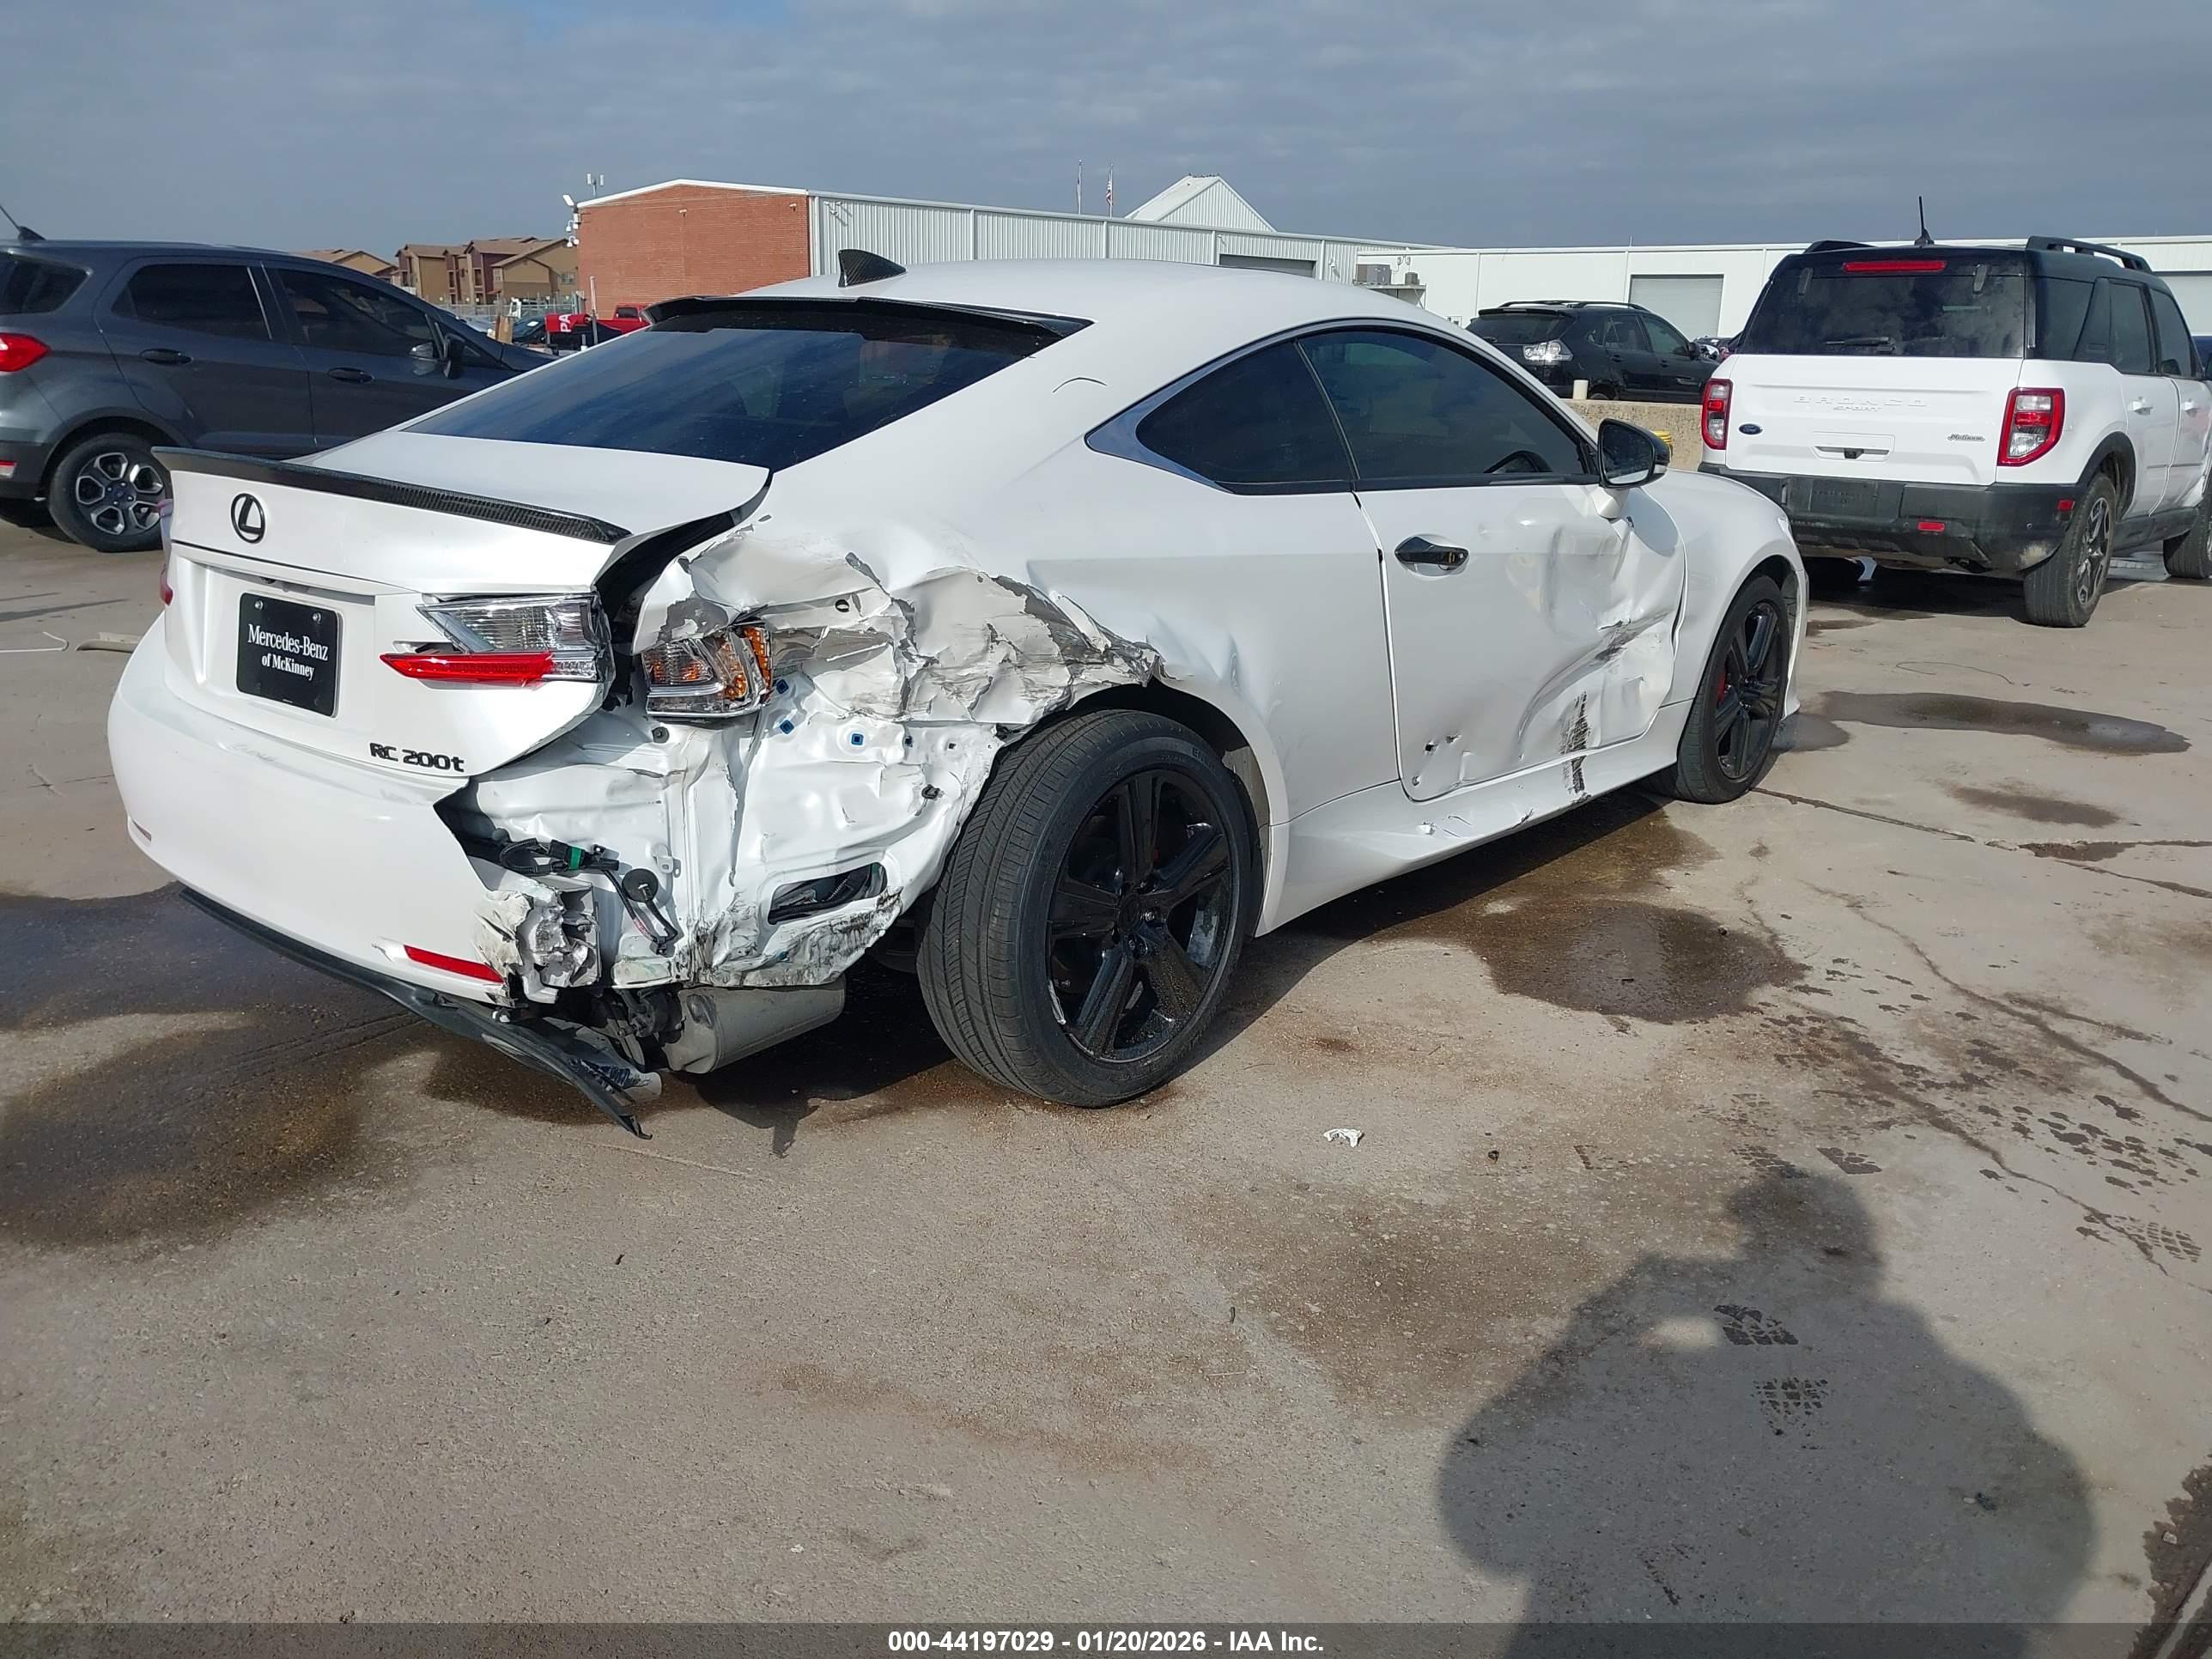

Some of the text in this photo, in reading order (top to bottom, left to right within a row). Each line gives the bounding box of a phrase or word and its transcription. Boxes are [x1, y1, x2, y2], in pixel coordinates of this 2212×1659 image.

[1793, 395, 1927, 408] BRONCO
[247, 623, 329, 661] Mercedes-Benz
[261, 653, 314, 681] of McKinney
[369, 742, 465, 773] RC 200t
